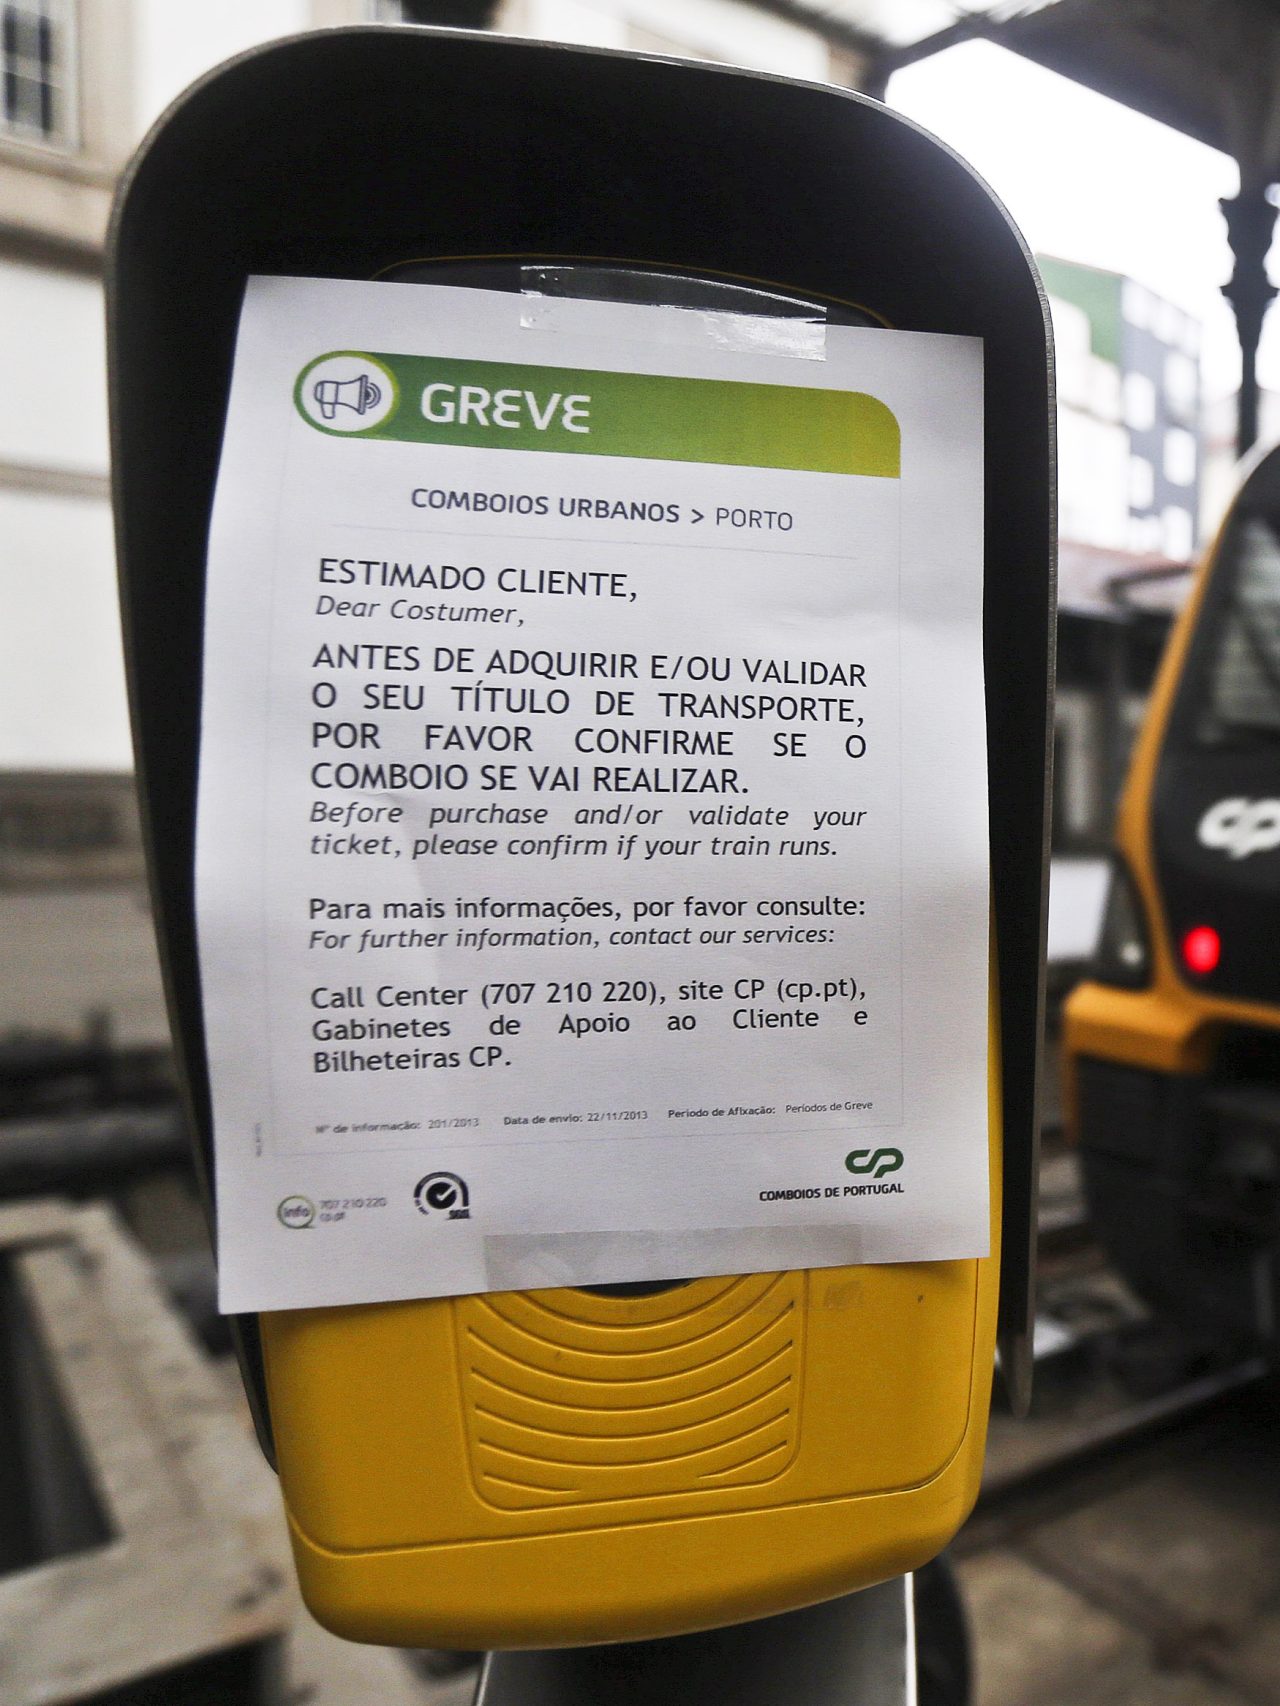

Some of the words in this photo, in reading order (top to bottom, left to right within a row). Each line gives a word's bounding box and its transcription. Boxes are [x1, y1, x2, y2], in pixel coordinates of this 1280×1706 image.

[421, 383, 591, 433] GREVE
[411, 488, 549, 515] COMBOIOS
[559, 497, 680, 523] URBANOS
[716, 507, 792, 531] PORTO
[319, 558, 485, 591] ESTIMADO
[497, 568, 637, 602] CLIENTE,
[315, 595, 381, 617] Dear
[390, 599, 524, 627] Costumer,
[312, 643, 420, 671] ANTES
[434, 647, 475, 673] DE
[485, 649, 639, 680] ADQUIRIR
[651, 655, 730, 681] E/OU
[742, 658, 867, 687] VALIDAR
[311, 682, 337, 708] O
[363, 683, 425, 710] SEU
[450, 680, 570, 714] TÍTULO
[595, 691, 635, 716] DE
[657, 693, 863, 728] TRANSPORTE,
[312, 722, 381, 749] POR
[425, 724, 534, 752] FAVOR
[575, 728, 734, 756] CONFIRME
[773, 732, 807, 757] SE
[845, 735, 866, 758] O
[311, 762, 469, 790] COMBOIO
[480, 765, 518, 790] SE
[528, 766, 579, 791] VAI
[593, 767, 748, 793] REALIZAR.
[310, 802, 404, 823] Before
[429, 803, 548, 829] purchase
[574, 803, 663, 825] and/or
[689, 805, 789, 825] validate
[813, 811, 867, 830] your
[311, 833, 401, 858] ticket,
[412, 834, 499, 860] please
[507, 834, 608, 860] confirm
[617, 835, 639, 860] if
[644, 840, 702, 860] your
[711, 835, 771, 855] train
[779, 841, 837, 856] runs.
[309, 898, 372, 919] Para
[383, 898, 447, 919] mais
[454, 897, 621, 923] informações,
[633, 901, 675, 922] por
[683, 896, 748, 917] favor
[756, 897, 865, 917] consulte:
[309, 930, 352, 949] For
[357, 929, 450, 953] further
[456, 927, 600, 951] information,
[609, 928, 693, 945] contact
[699, 930, 737, 944] our
[742, 926, 836, 944] services:
[311, 986, 365, 1009] Call
[376, 986, 469, 1007] Center
[481, 983, 536, 1010] (707
[546, 982, 593, 1003] 210
[602, 981, 666, 1006] 220),
[679, 981, 724, 1001] site
[732, 979, 765, 999] CP
[775, 978, 866, 1005] (cp.pt),
[312, 1018, 451, 1041] Gabinetes
[489, 1014, 522, 1035] de
[558, 1012, 630, 1038] Apoio
[667, 1013, 696, 1031] ao
[733, 1008, 820, 1029] Cliente
[853, 1011, 869, 1027] e
[313, 1048, 461, 1073] Bilheteiras
[469, 1046, 512, 1067] CP.
[333, 1123, 349, 1133] de
[503, 1114, 529, 1126] Data
[531, 1115, 546, 1126] de
[549, 1113, 584, 1125] envio:
[586, 1110, 649, 1123] 22/11/2013
[712, 1107, 725, 1117] de
[829, 1102, 842, 1112] de
[844, 1101, 873, 1111] Greve
[759, 1188, 822, 1201] COMBOIOS
[823, 1187, 840, 1198] DE
[843, 1183, 905, 1197] PORTUGAL
[284, 1205, 310, 1217] info
